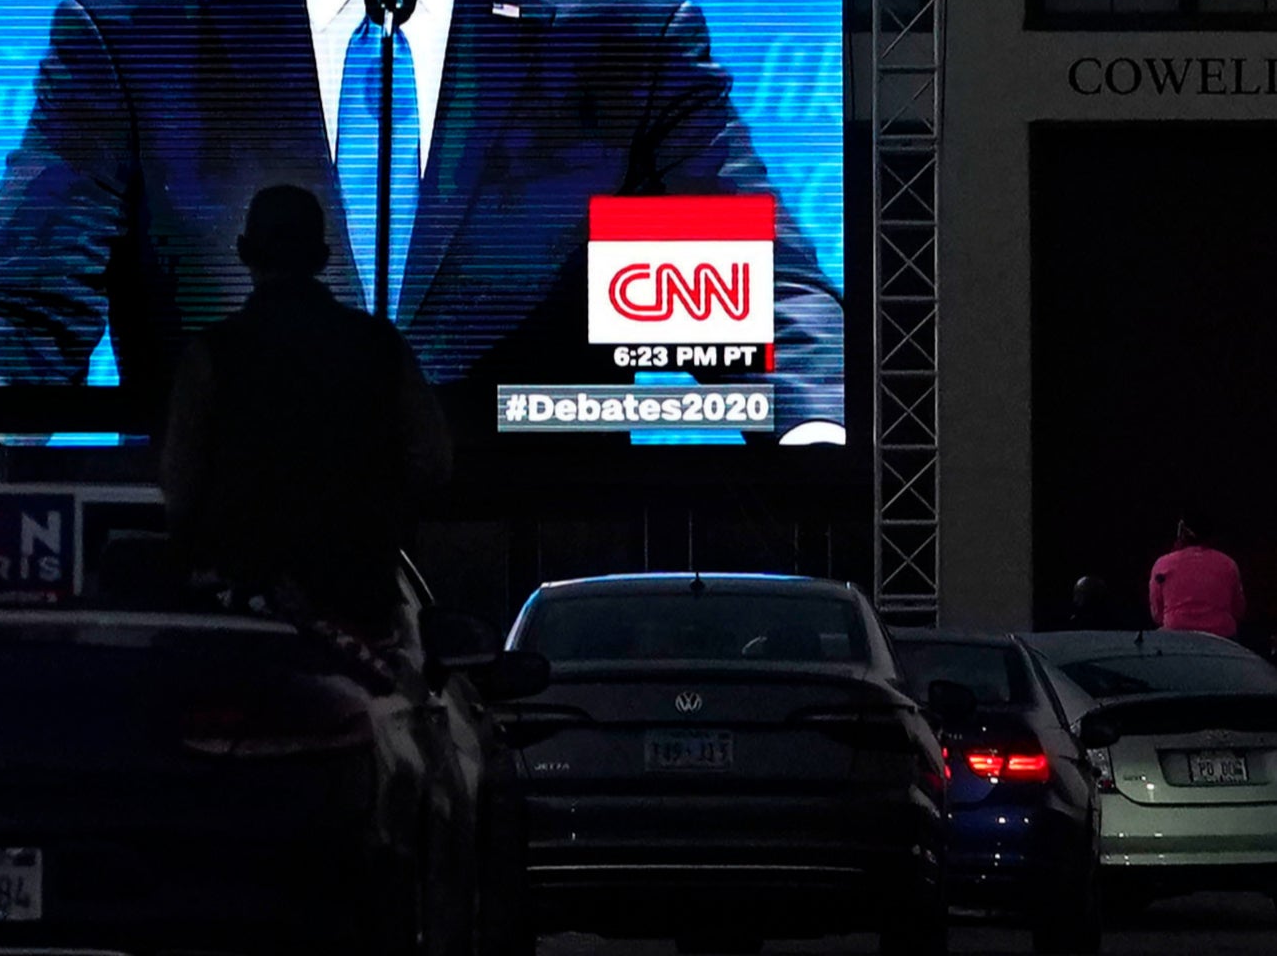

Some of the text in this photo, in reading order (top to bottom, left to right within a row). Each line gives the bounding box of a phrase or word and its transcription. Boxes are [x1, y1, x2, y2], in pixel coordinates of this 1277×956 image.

[608, 262, 750, 322] CNN
[613, 346, 757, 367] 6:23 PM PT
[505, 393, 769, 422] #Debates2020
